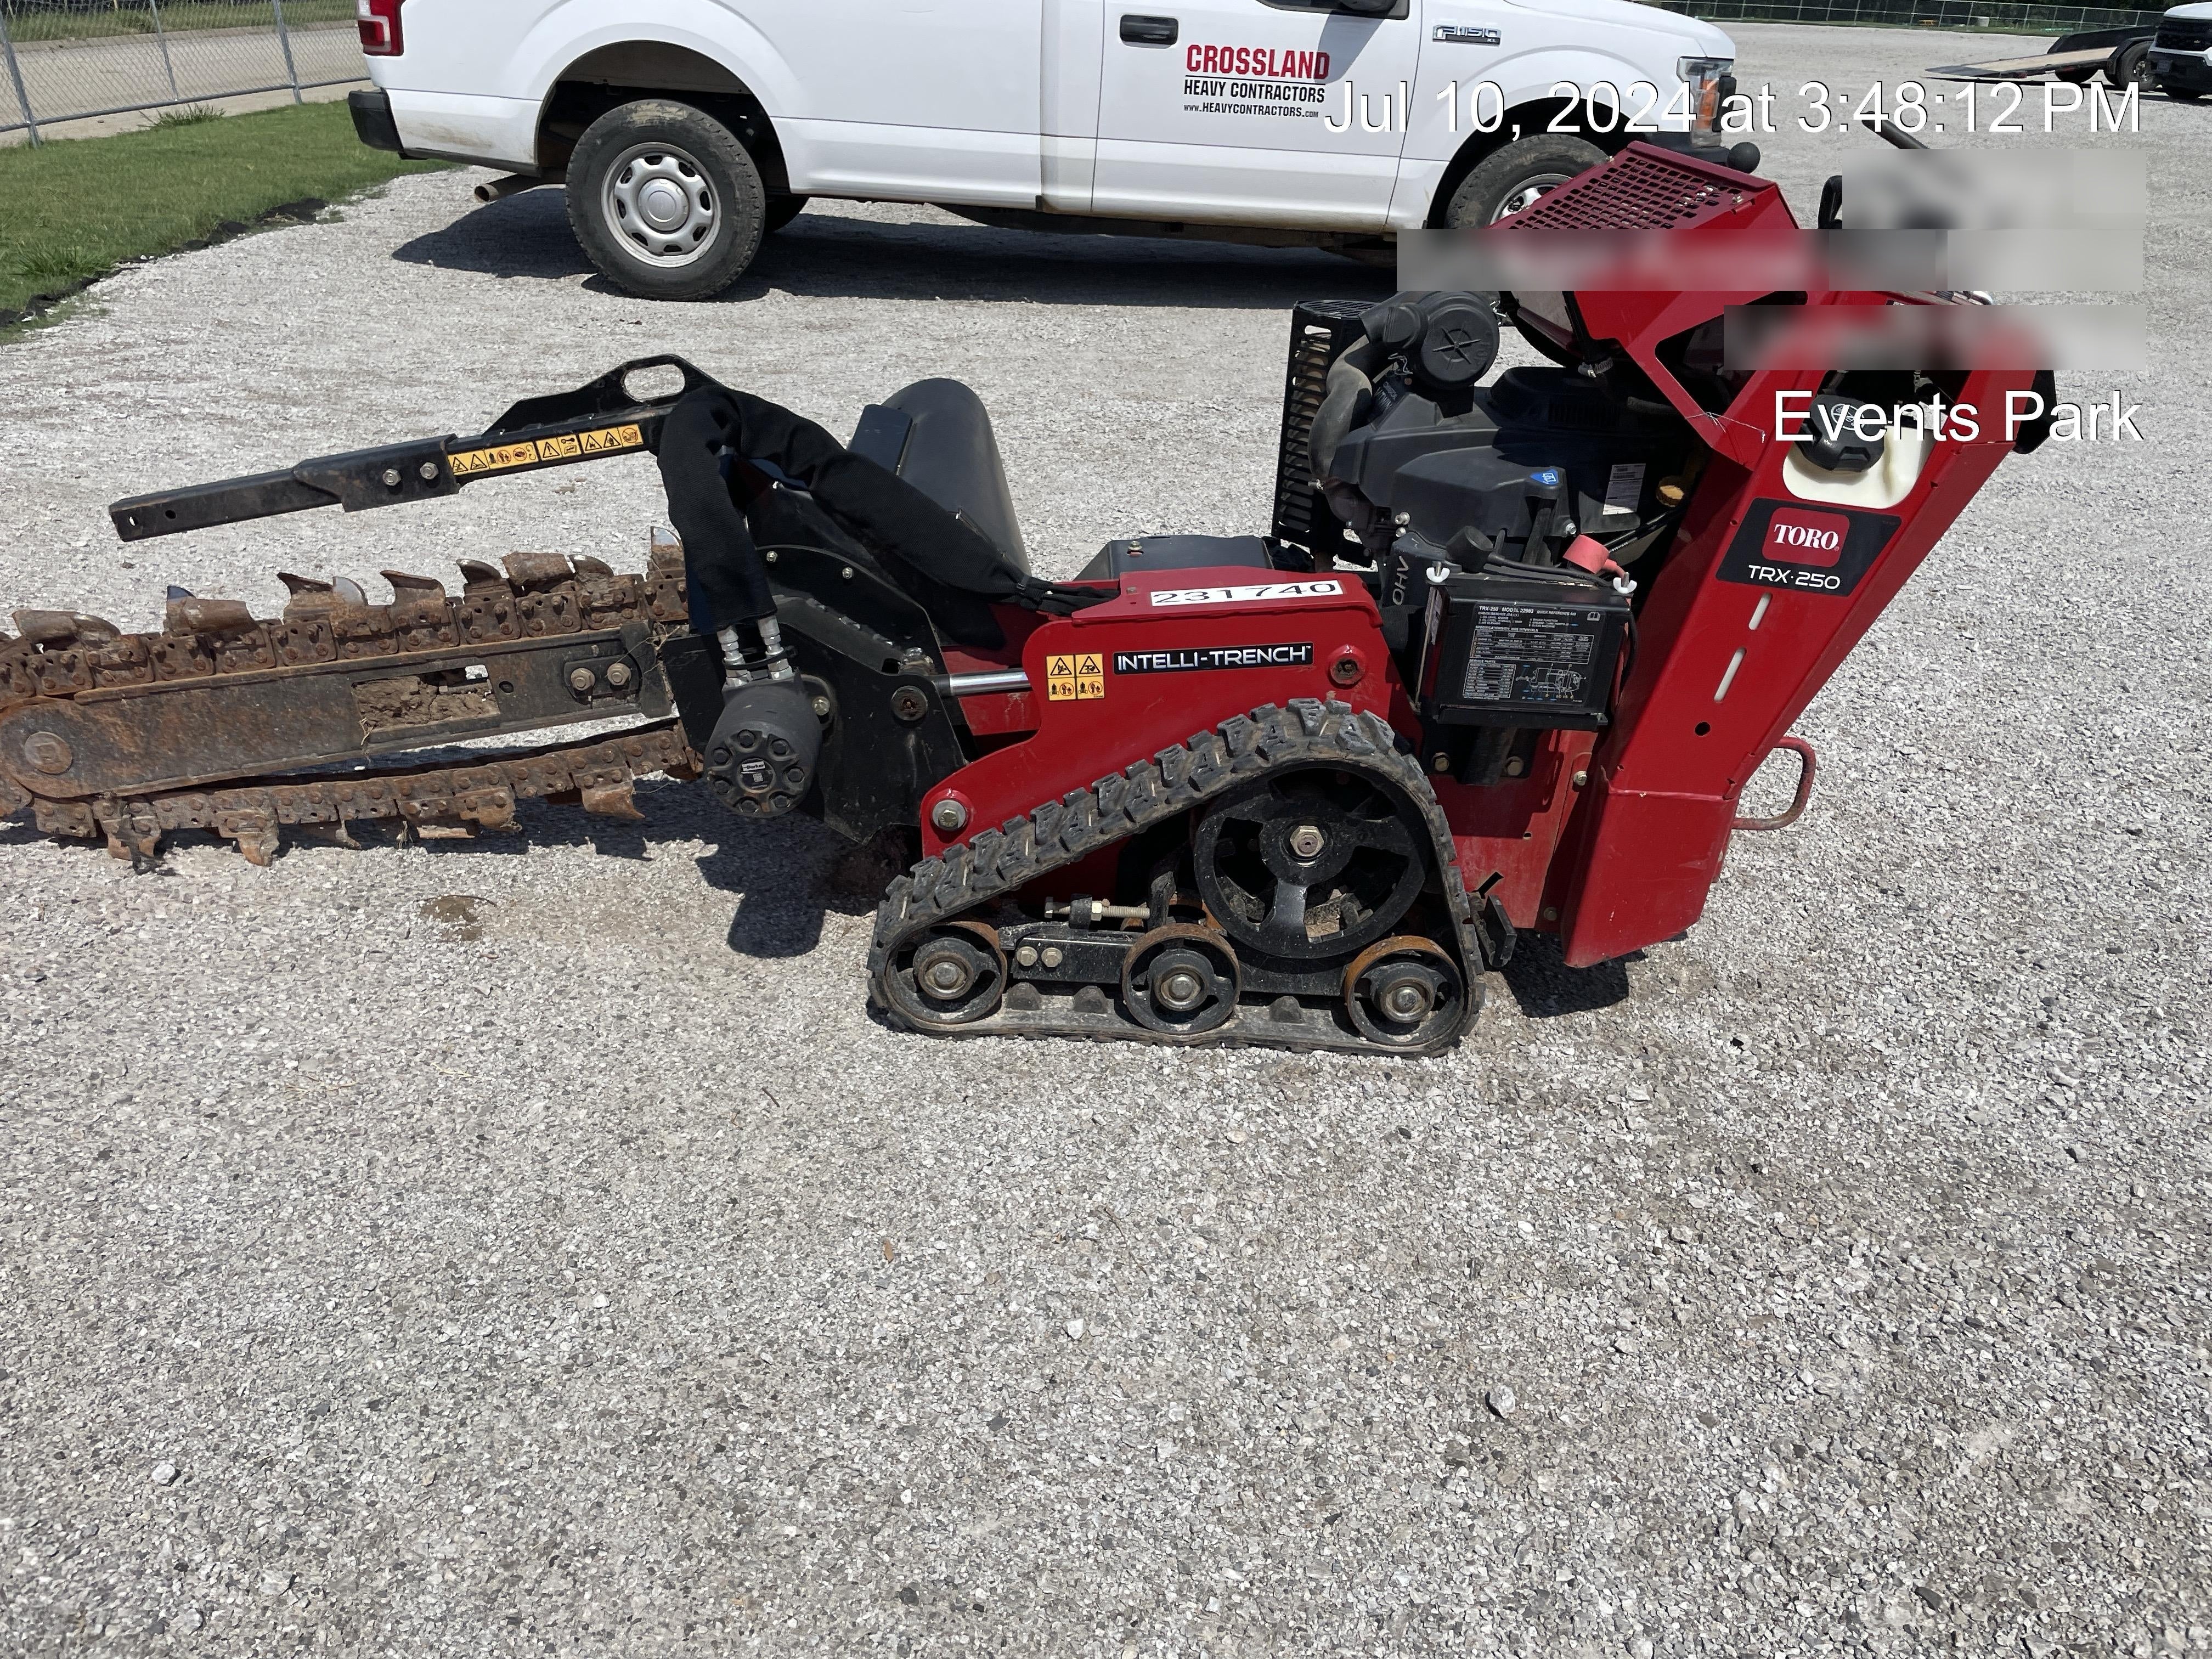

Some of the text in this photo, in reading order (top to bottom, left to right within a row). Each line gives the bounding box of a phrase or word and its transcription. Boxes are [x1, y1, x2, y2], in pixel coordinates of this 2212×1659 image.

[1187, 44, 1330, 80] CROSSLAND
[1184, 80, 1325, 103] HEAVY CONTRACTORS
[1774, 524, 1839, 550] TORO
[1153, 583, 1336, 603] 231740
[1392, 555, 1409, 606] OHV
